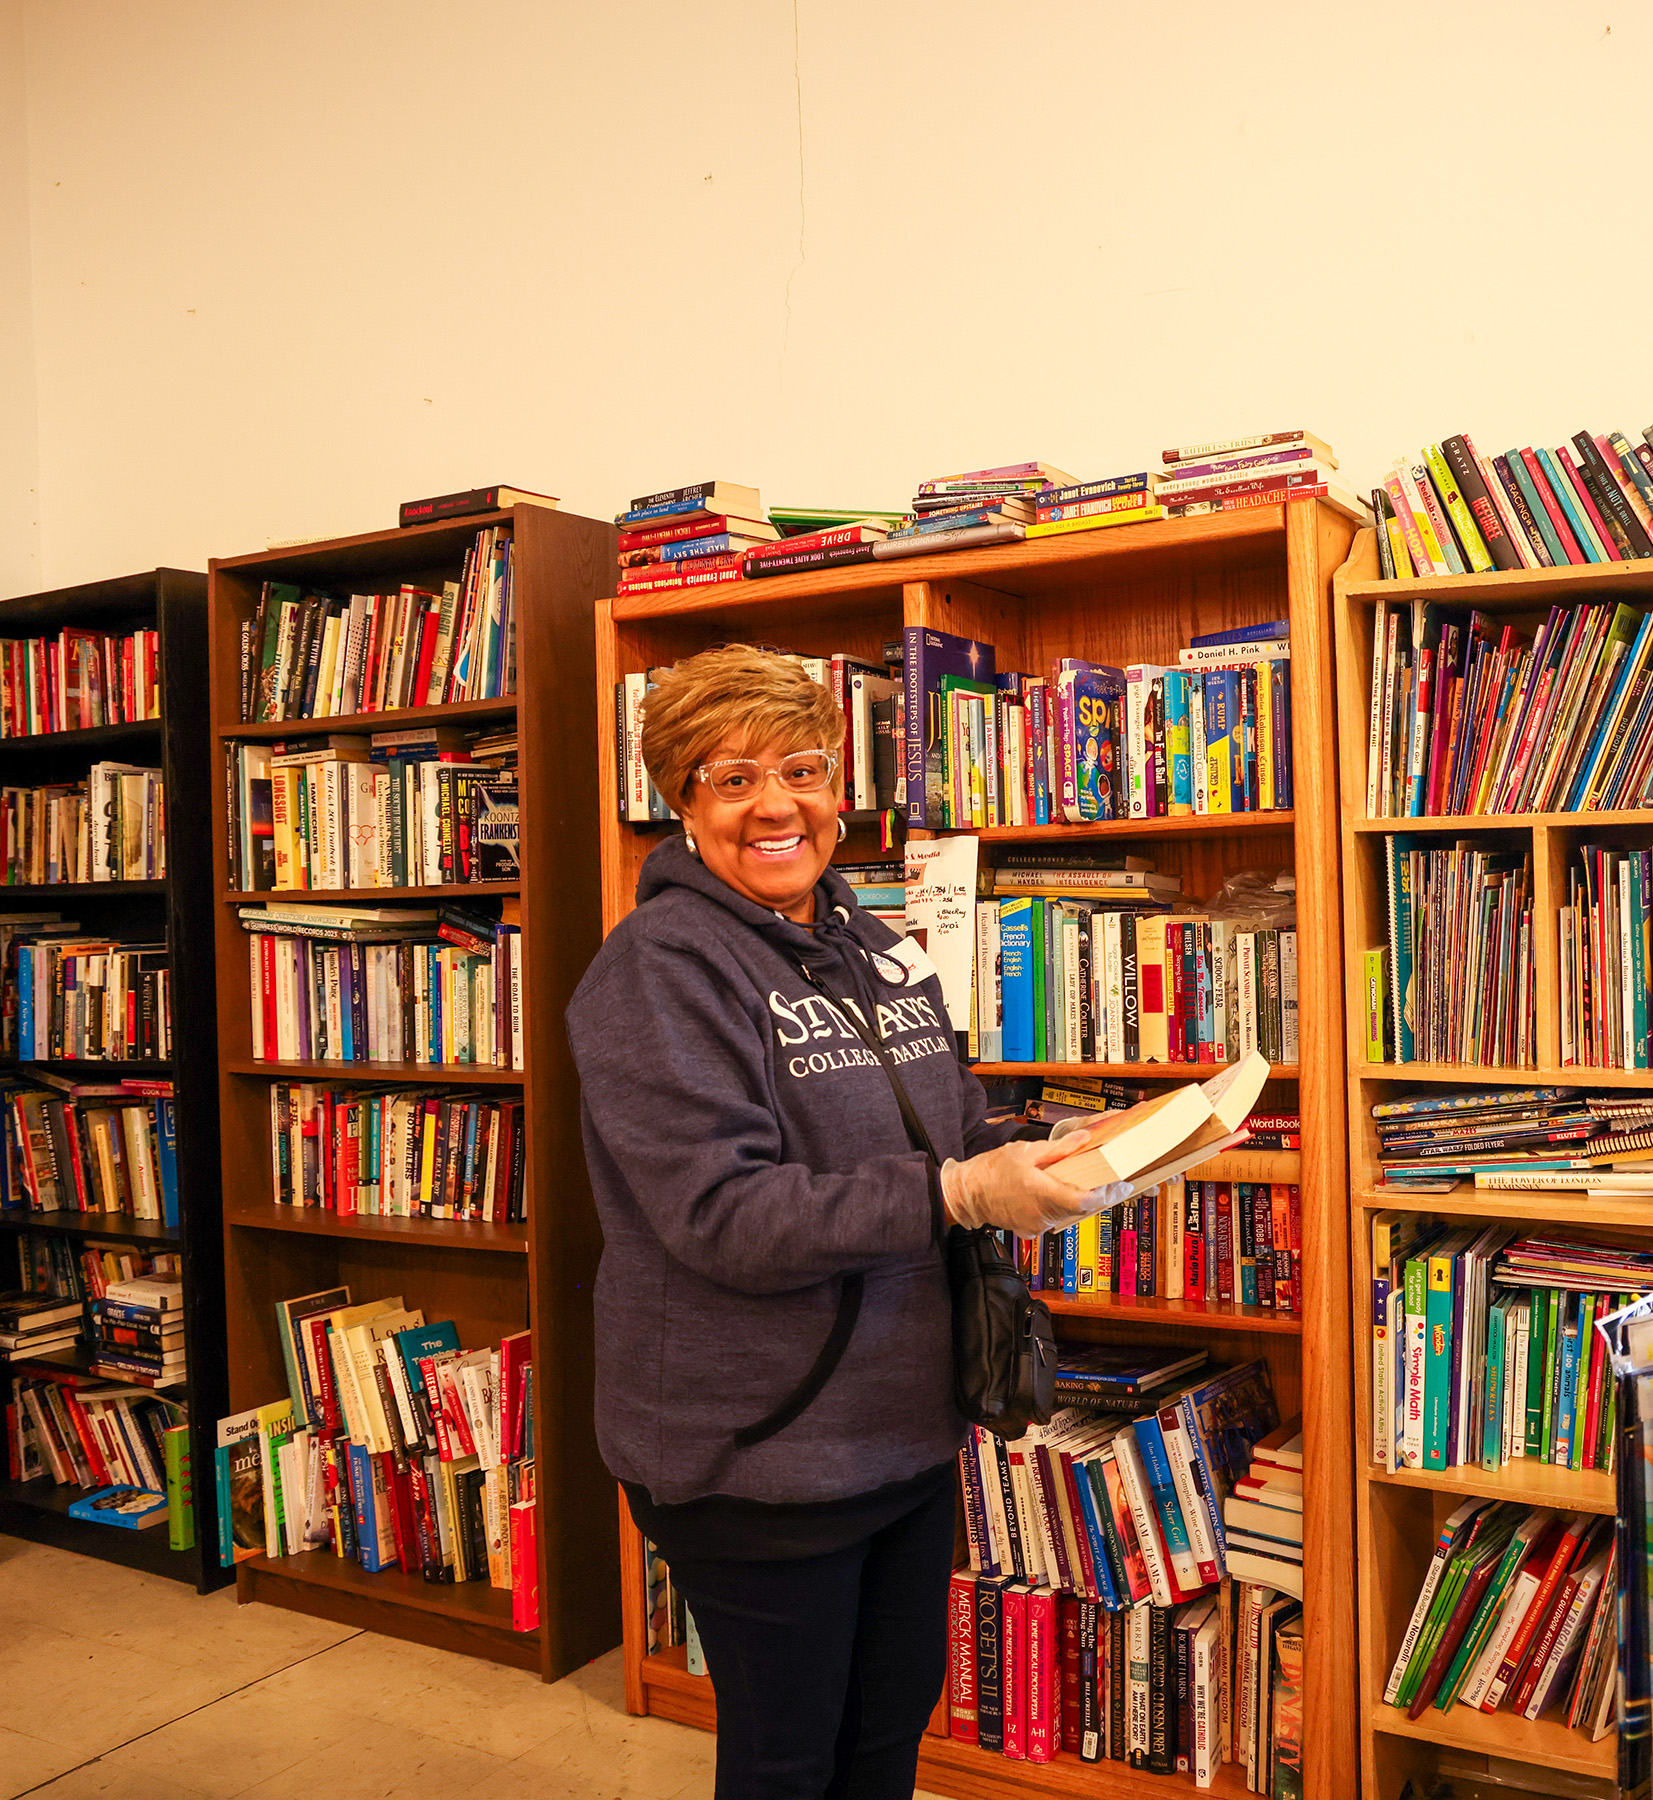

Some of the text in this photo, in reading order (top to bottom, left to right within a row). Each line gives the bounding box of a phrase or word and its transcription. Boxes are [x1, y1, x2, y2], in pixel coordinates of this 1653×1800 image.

[1450, 441, 1468, 476] GRATZ
[404, 504, 433, 517] Knockout
[1236, 489, 1287, 508] HEADACHE
[438, 591, 454, 636] STRAIGHT
[1198, 645, 1260, 660] Daniel H. Pink
[907, 632, 922, 782] IN THE FOOTSTEPS OF JESUS
[1217, 703, 1226, 730] RUMP
[1372, 700, 1379, 712] My
[1210, 756, 1218, 786] GRUMP
[274, 775, 287, 824] LONGSHOT
[440, 783, 452, 854] MICHAEL CONNELLY
[250, 921, 278, 931] GUINNESS
[278, 925, 296, 933] WORLD
[980, 912, 988, 937] Health
[1184, 930, 1192, 956] NIELSEN
[1243, 947, 1251, 969] PRIVATE
[1079, 958, 1090, 1038] CATHERINE COULTER
[1124, 954, 1137, 1028] WILLOW
[1184, 972, 1196, 1020] ICEBERG
[1284, 962, 1292, 1000] BRETHREN
[512, 1005, 518, 1013] TO
[1284, 1010, 1292, 1047] GRISHAM
[1250, 1118, 1300, 1128] Word Book
[405, 1112, 414, 1180] ROTTWEILERS
[433, 1158, 442, 1196] REAL BOY
[1066, 1236, 1074, 1260] GOOD
[1100, 1222, 1112, 1254] EVANOVICH
[1218, 1216, 1230, 1260] NORA ROBERTS
[1098, 1256, 1106, 1277] FIVE
[1189, 1240, 1198, 1286] Mario Puzo
[424, 1373, 439, 1404] LEE CHILD
[1057, 1396, 1140, 1409] WORLD OF NATURE
[226, 1421, 248, 1437] Stand
[1000, 1461, 1018, 1538] BEYOND TEAMS
[1179, 1473, 1206, 1555] Complete Wine Course
[1134, 1506, 1150, 1538] TEAM
[1163, 1501, 1185, 1546] Silver Girl
[1144, 1546, 1162, 1585] TEAMS
[979, 1589, 998, 1698] ROGET'S II
[1005, 1616, 1013, 1636] HOME
[1080, 1603, 1088, 1648] Rising Sun
[1087, 1604, 1096, 1649] Killing the
[1134, 1612, 1142, 1652] WARREN
[950, 1587, 960, 1703] OF MEDICAL INFORMATION
[958, 1590, 973, 1703] MERCK MANUAL
[1152, 1609, 1166, 1755] JOHN SANDFORD CHOSEN PREY
[1178, 1633, 1187, 1699] ROBERT HARRIS
[1005, 1667, 1013, 1716] ENCYCLOPEDIA
[1132, 1690, 1139, 1701] AM
[1240, 1650, 1252, 1728] ANIMAL KINGDOM
[1139, 1712, 1146, 1722] ON
[1197, 1684, 1206, 1750] WHY WE'RE CATHOLIC
[1279, 1662, 1303, 1772] DYNASTY
